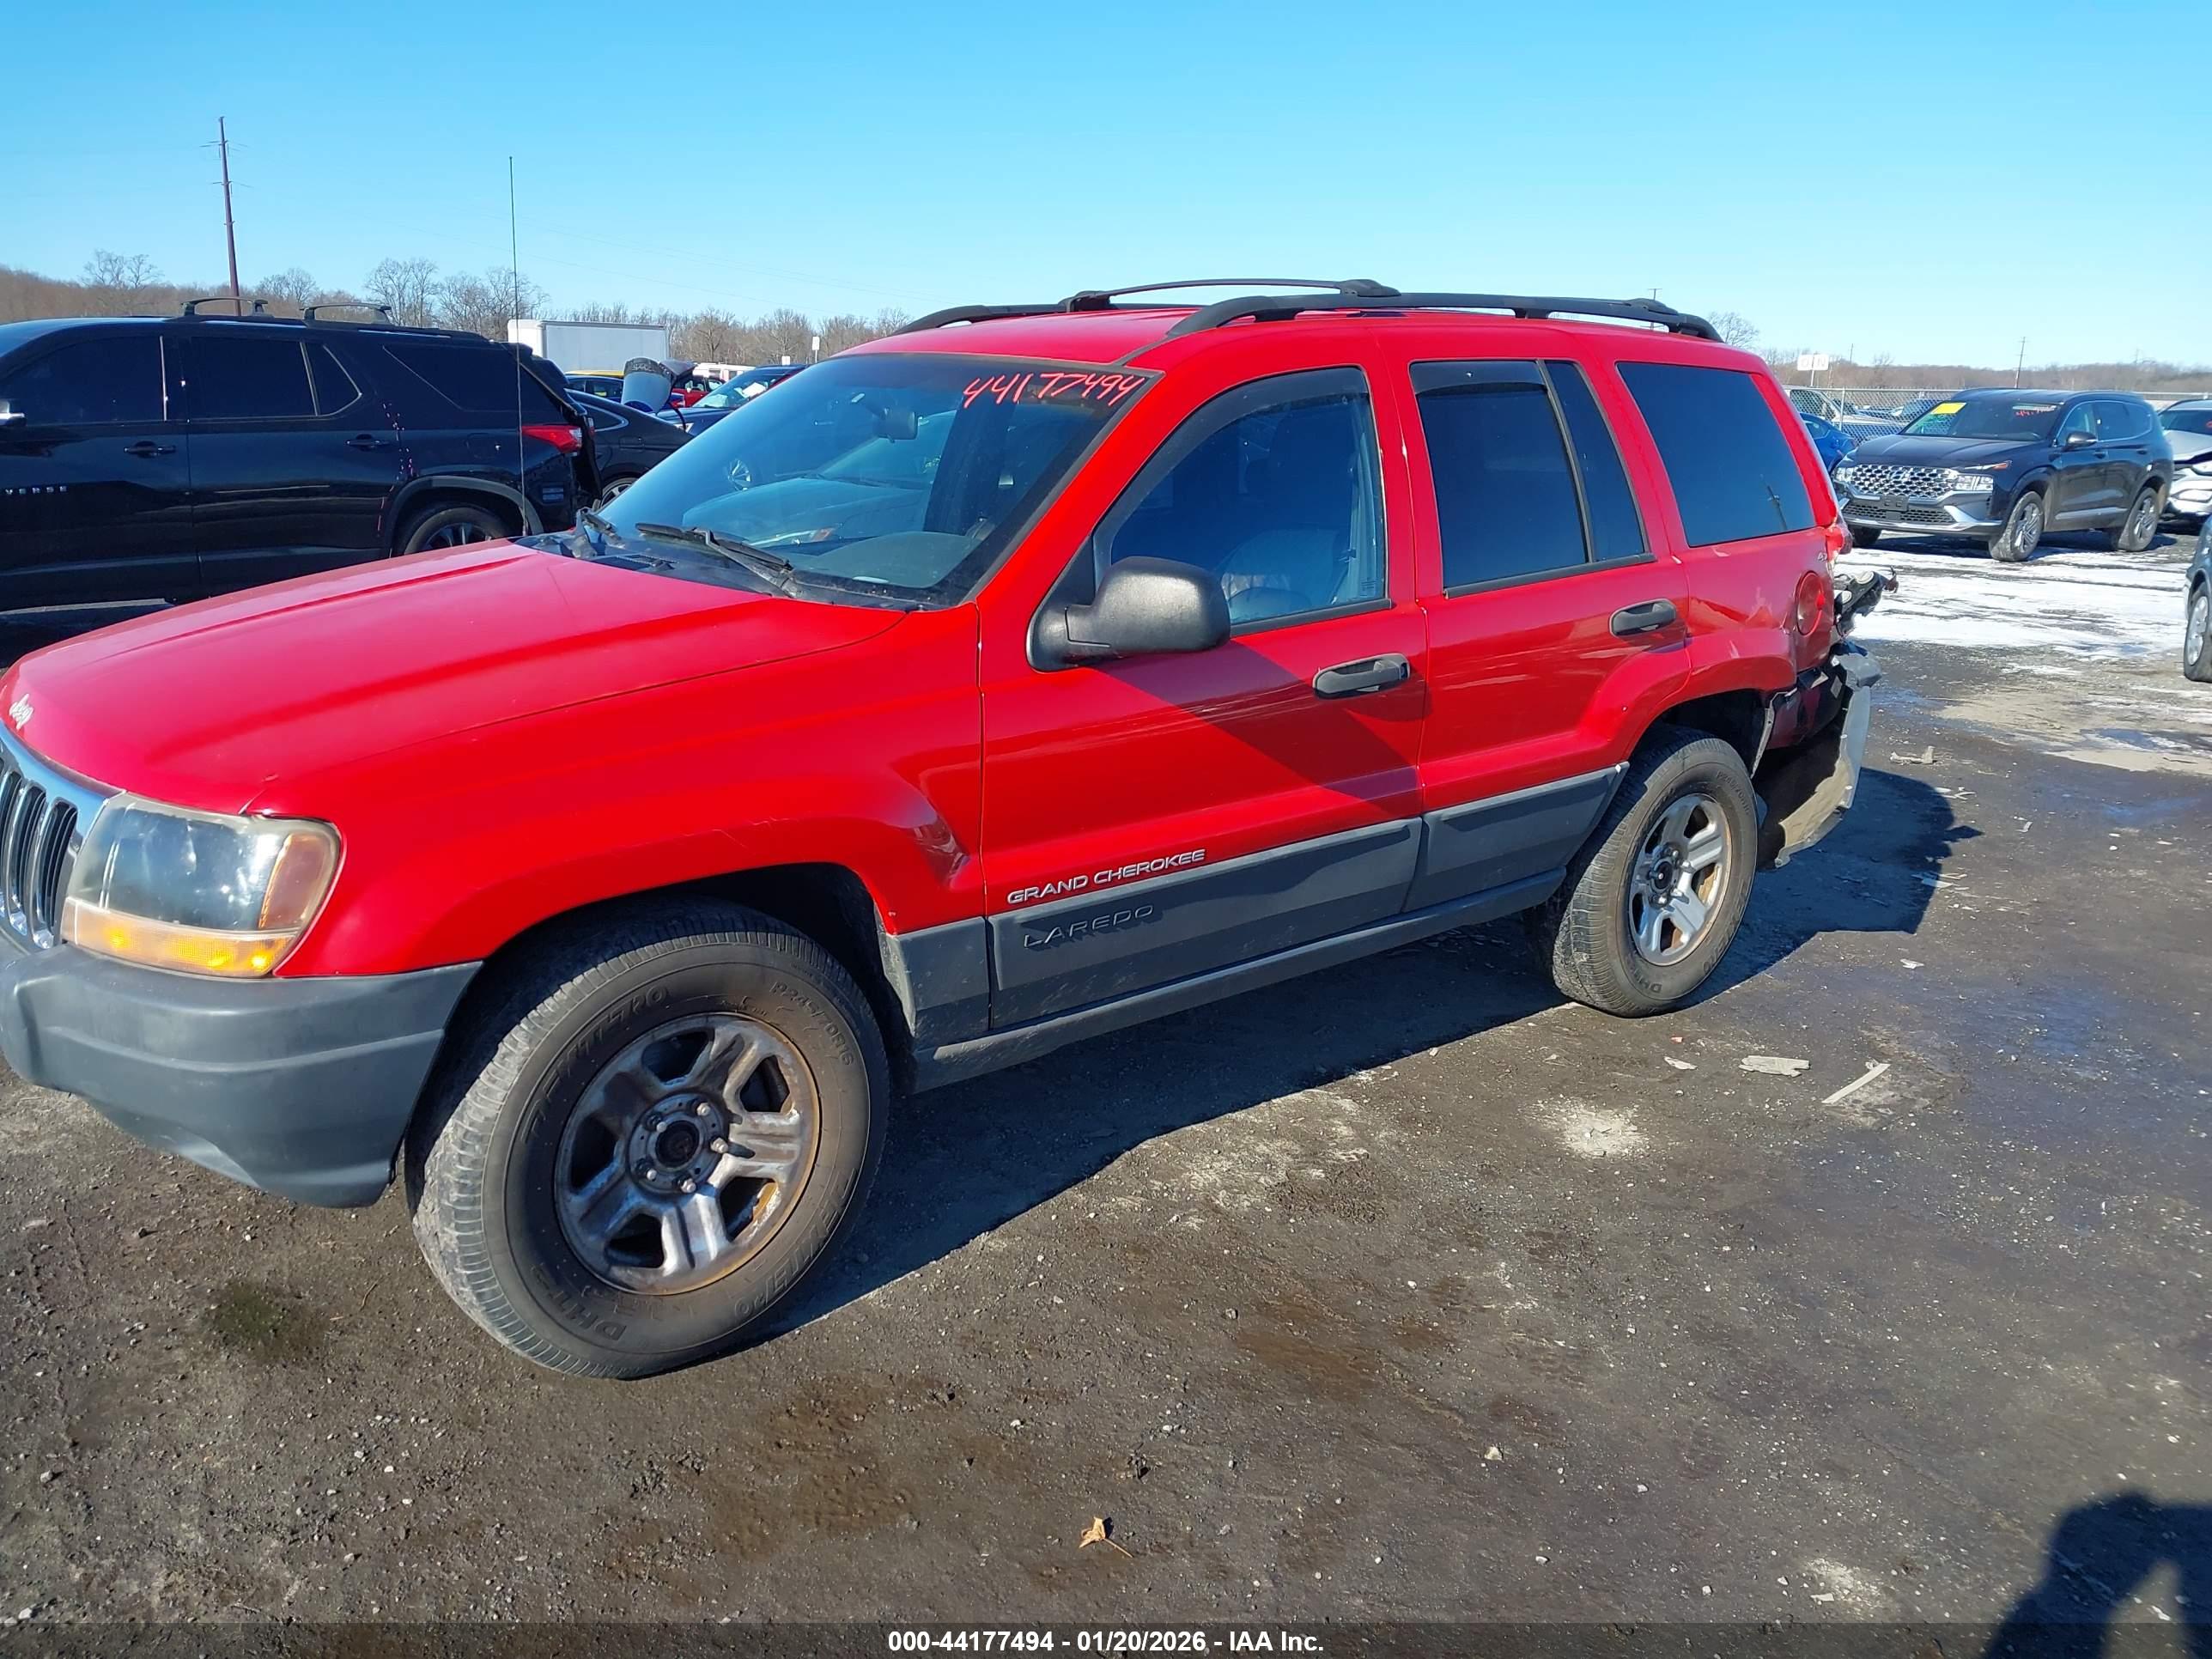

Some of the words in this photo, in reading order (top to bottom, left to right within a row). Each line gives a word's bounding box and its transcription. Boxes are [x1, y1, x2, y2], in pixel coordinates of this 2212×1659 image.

[1006, 874, 1090, 904] GRAND
[1093, 848, 1206, 885] CHEROKEE
[1023, 904, 1154, 949] LAREDO
